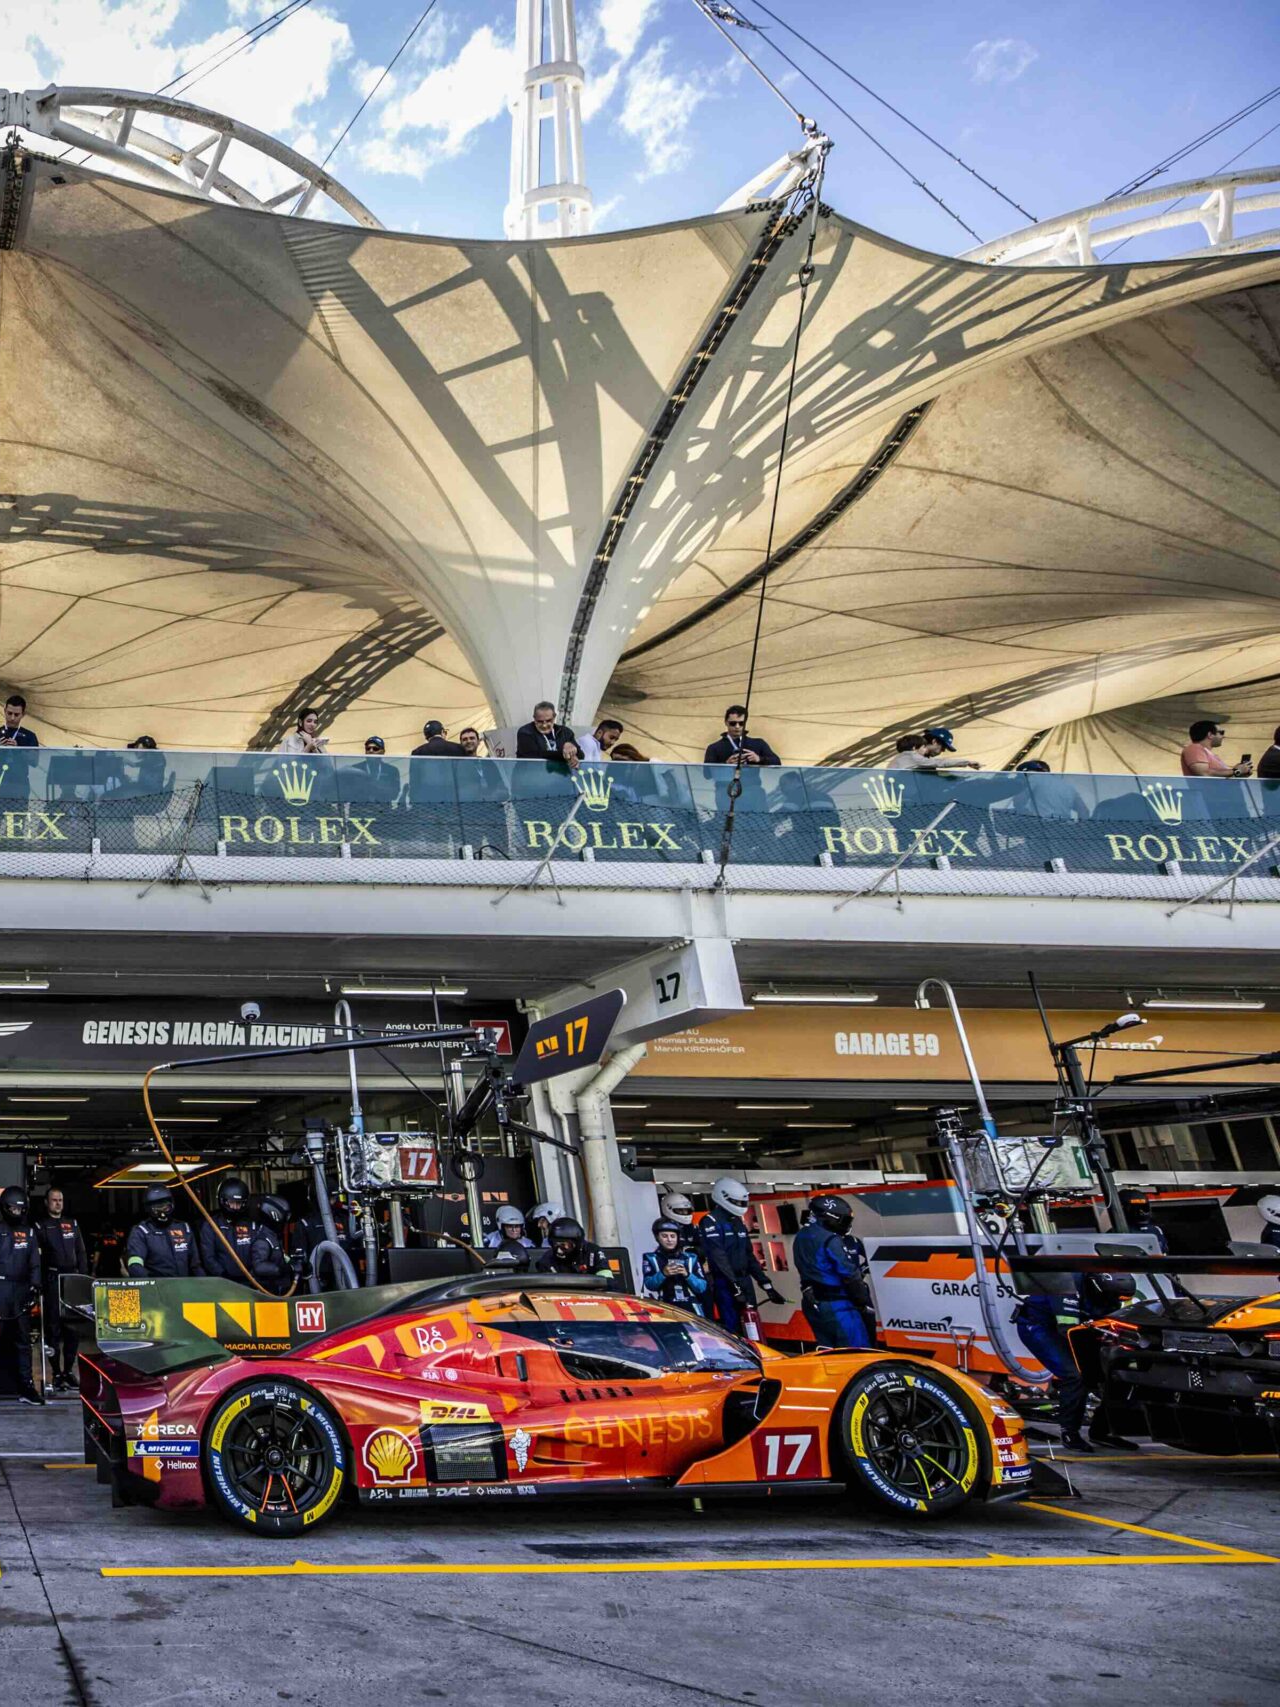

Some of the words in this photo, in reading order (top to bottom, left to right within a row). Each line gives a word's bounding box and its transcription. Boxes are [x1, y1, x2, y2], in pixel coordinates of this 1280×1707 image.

[222, 816, 381, 845] ROLEX
[525, 821, 682, 851] ROLEX
[819, 826, 976, 857] ROLEX
[1105, 834, 1258, 862] ROLEX
[656, 972, 680, 1004] 17
[82, 1020, 170, 1044] GENESIS
[172, 1022, 246, 1046] MAGMA
[249, 1023, 327, 1046] RACING
[385, 1022, 411, 1031] André
[565, 1016, 588, 1056] 17
[653, 1045, 683, 1053] Marvin
[688, 1037, 730, 1045] FLEMING
[835, 1032, 910, 1056] GARAGE
[913, 1033, 940, 1056] 59
[407, 1151, 433, 1177] 17
[931, 1282, 981, 1298] GARAG
[299, 1307, 322, 1327] HY
[886, 1318, 948, 1332] McLaren
[224, 1342, 257, 1351] MAGMA
[258, 1342, 292, 1351] RACING
[430, 1406, 481, 1419] DHL
[923, 1382, 968, 1424] MICHELIN
[148, 1424, 197, 1435] ORECA
[315, 1413, 343, 1465] MICHELIN
[564, 1408, 714, 1449] GENESIS
[148, 1445, 192, 1453] MICHELIN
[765, 1434, 812, 1476] 17
[167, 1460, 198, 1470] Helinox
[212, 1455, 240, 1510] MICHELIN
[436, 1486, 470, 1497] DAC
[486, 1485, 513, 1495] Helinox
[862, 1461, 908, 1505] MICHELIN
